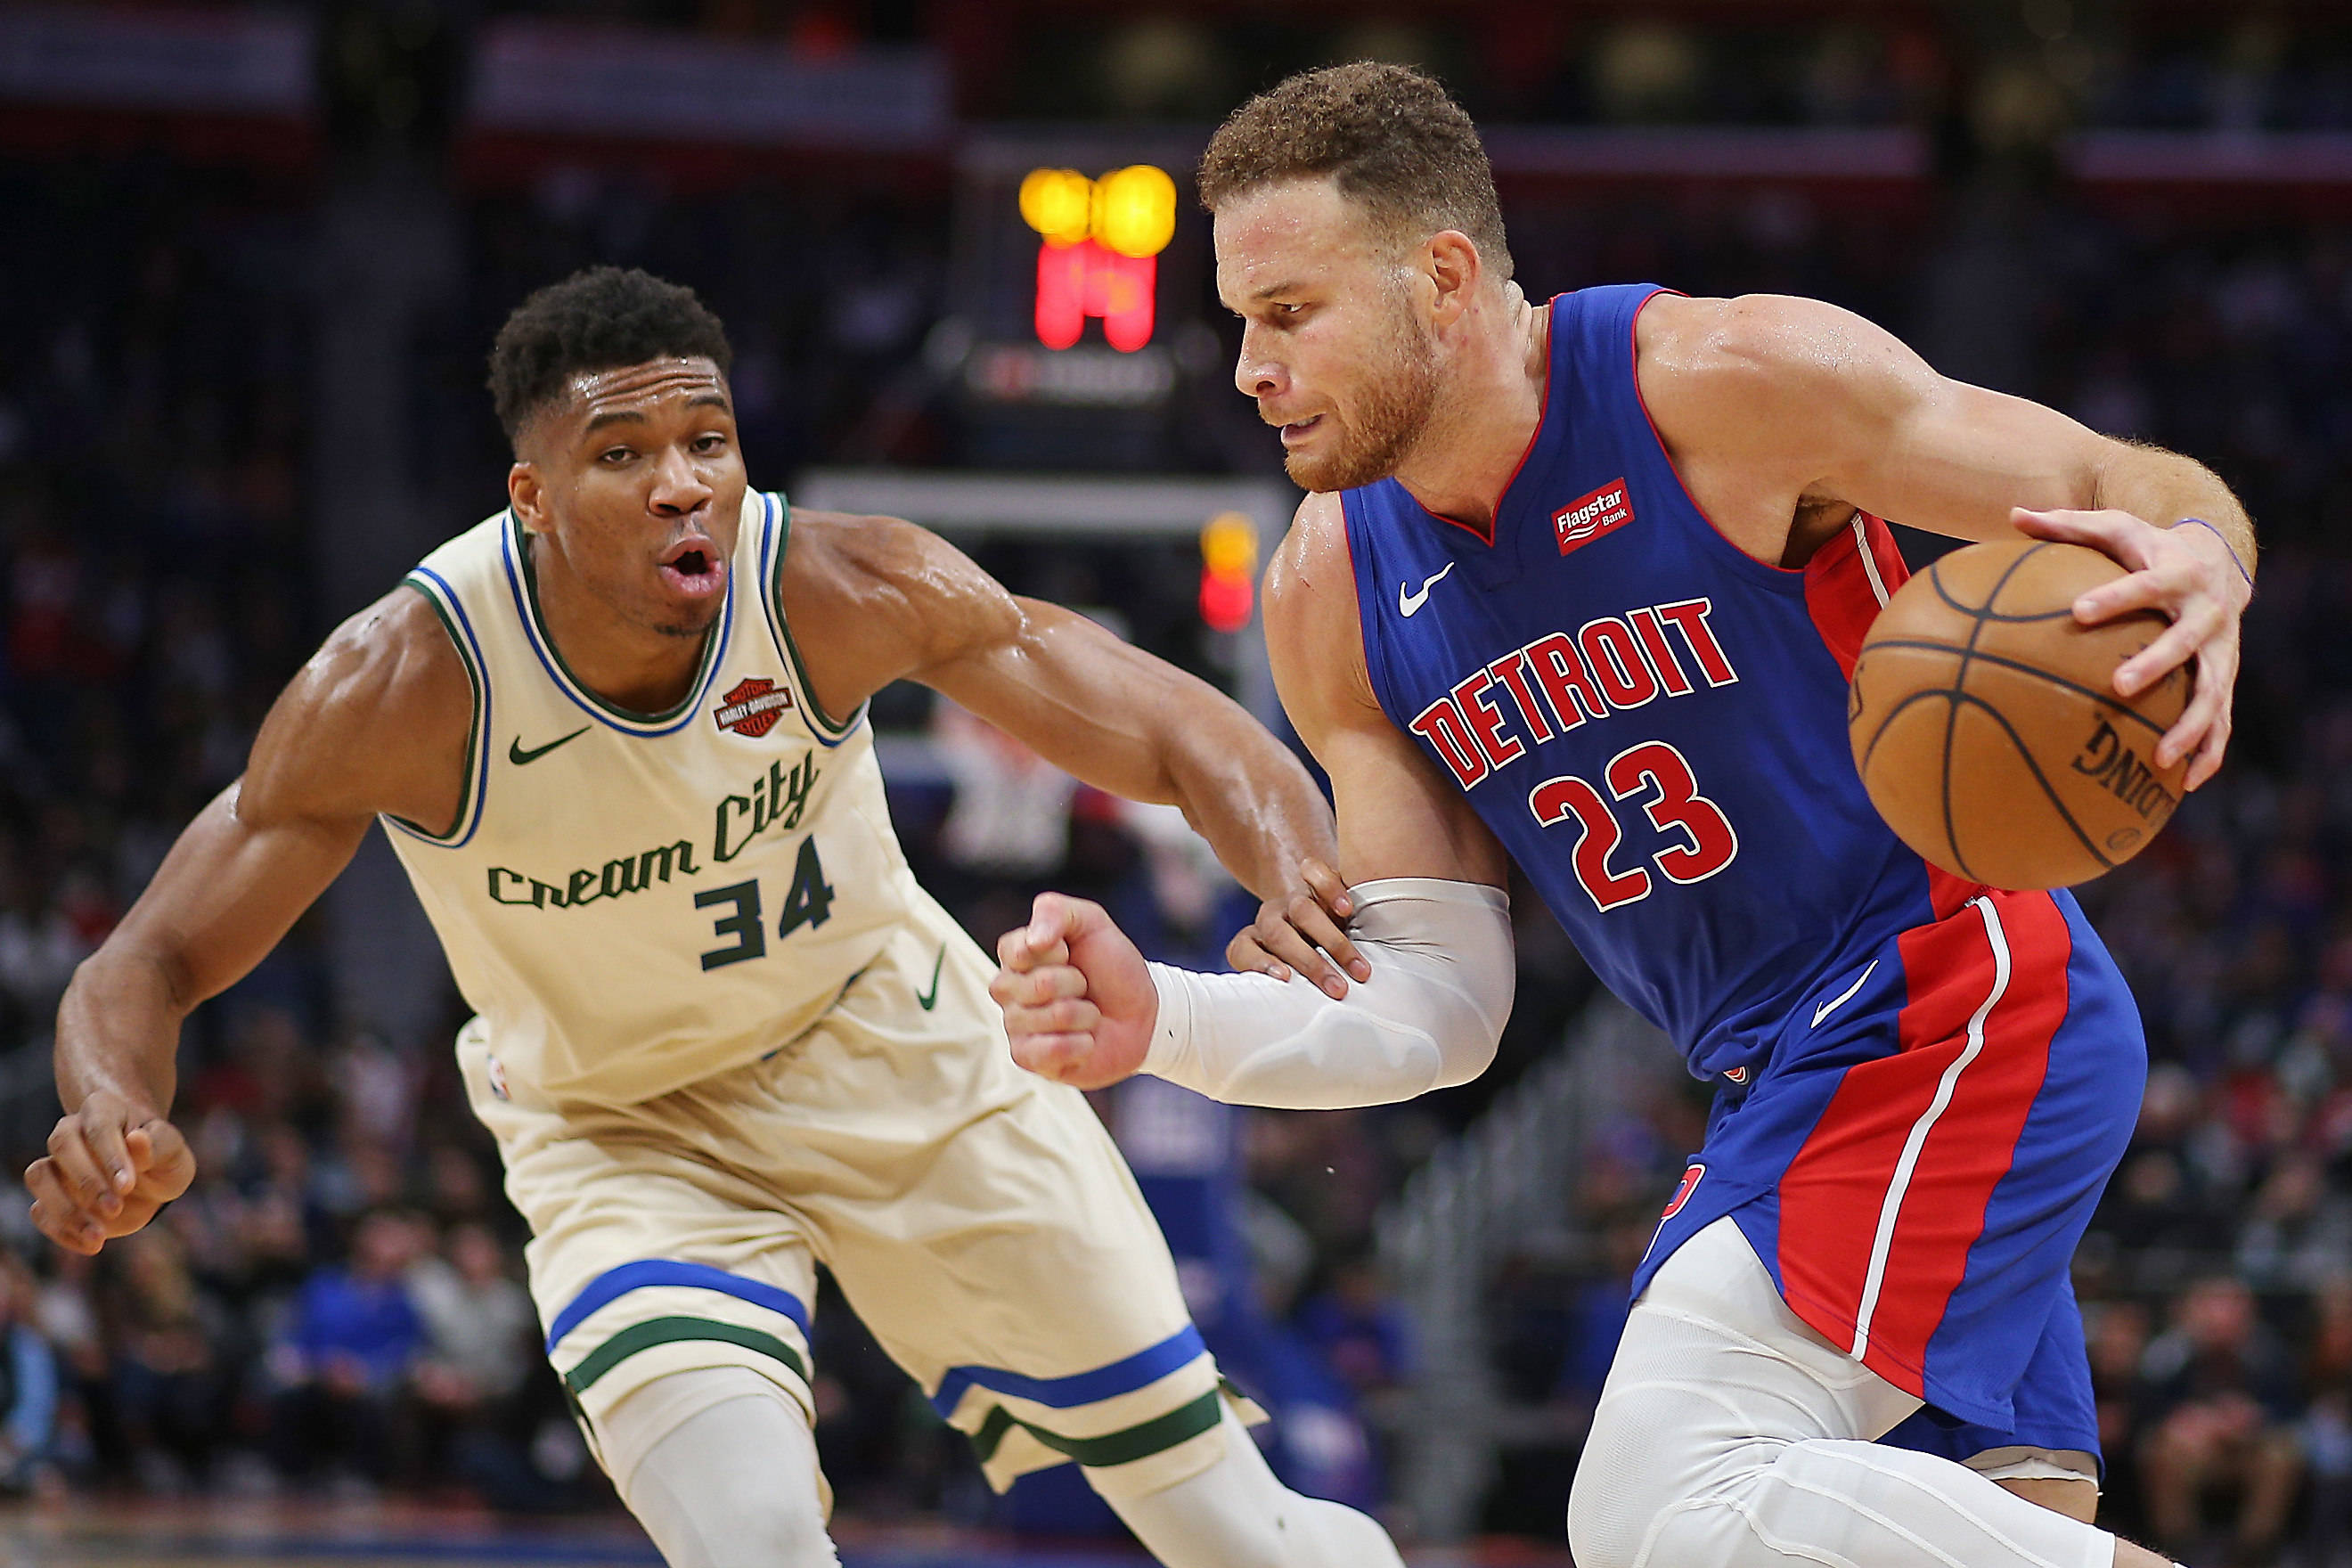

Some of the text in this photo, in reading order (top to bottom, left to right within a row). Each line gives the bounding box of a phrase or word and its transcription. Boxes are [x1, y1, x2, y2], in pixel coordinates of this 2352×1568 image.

[1556, 489, 1622, 534] Flagstar
[1601, 508, 1628, 527] Bank
[1409, 597, 1739, 791] DETROIT
[488, 749, 821, 910] Cream City
[1529, 740, 1738, 912] 23
[694, 834, 835, 971] 34
